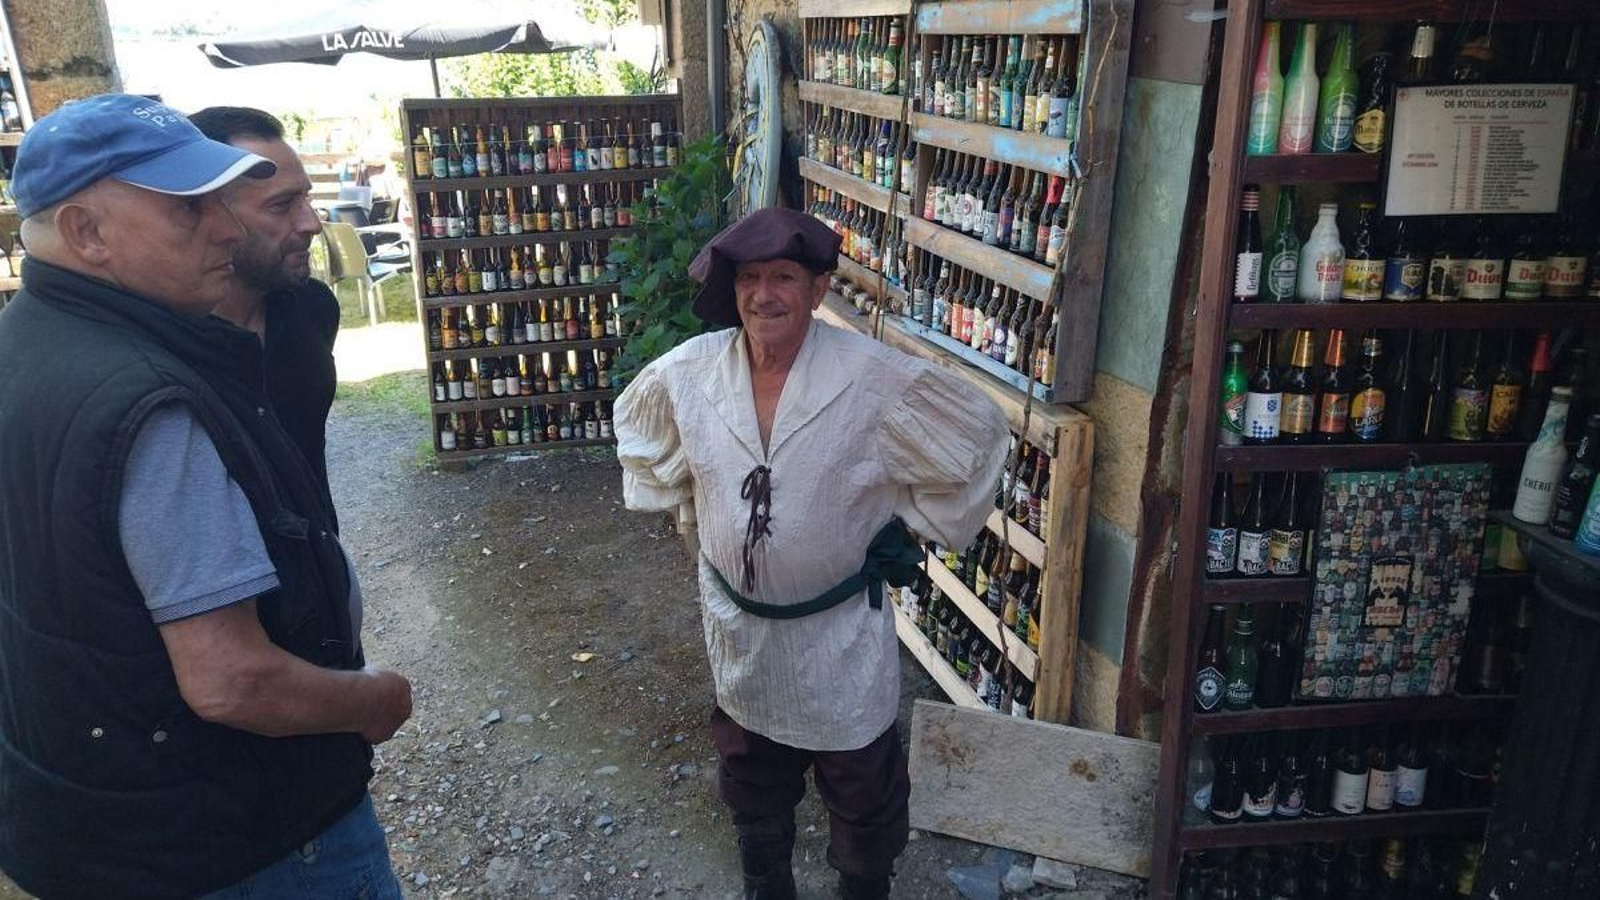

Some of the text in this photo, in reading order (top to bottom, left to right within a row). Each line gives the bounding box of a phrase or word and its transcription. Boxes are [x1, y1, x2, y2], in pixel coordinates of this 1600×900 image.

[322, 31, 405, 52] LA SALVE
[1425, 88, 1464, 98] MAYORES
[1466, 88, 1522, 98] COLECCIONES
[1523, 88, 1535, 98] DE
[1444, 99, 1547, 109] DE BOTELLAS DE CERVEZA
